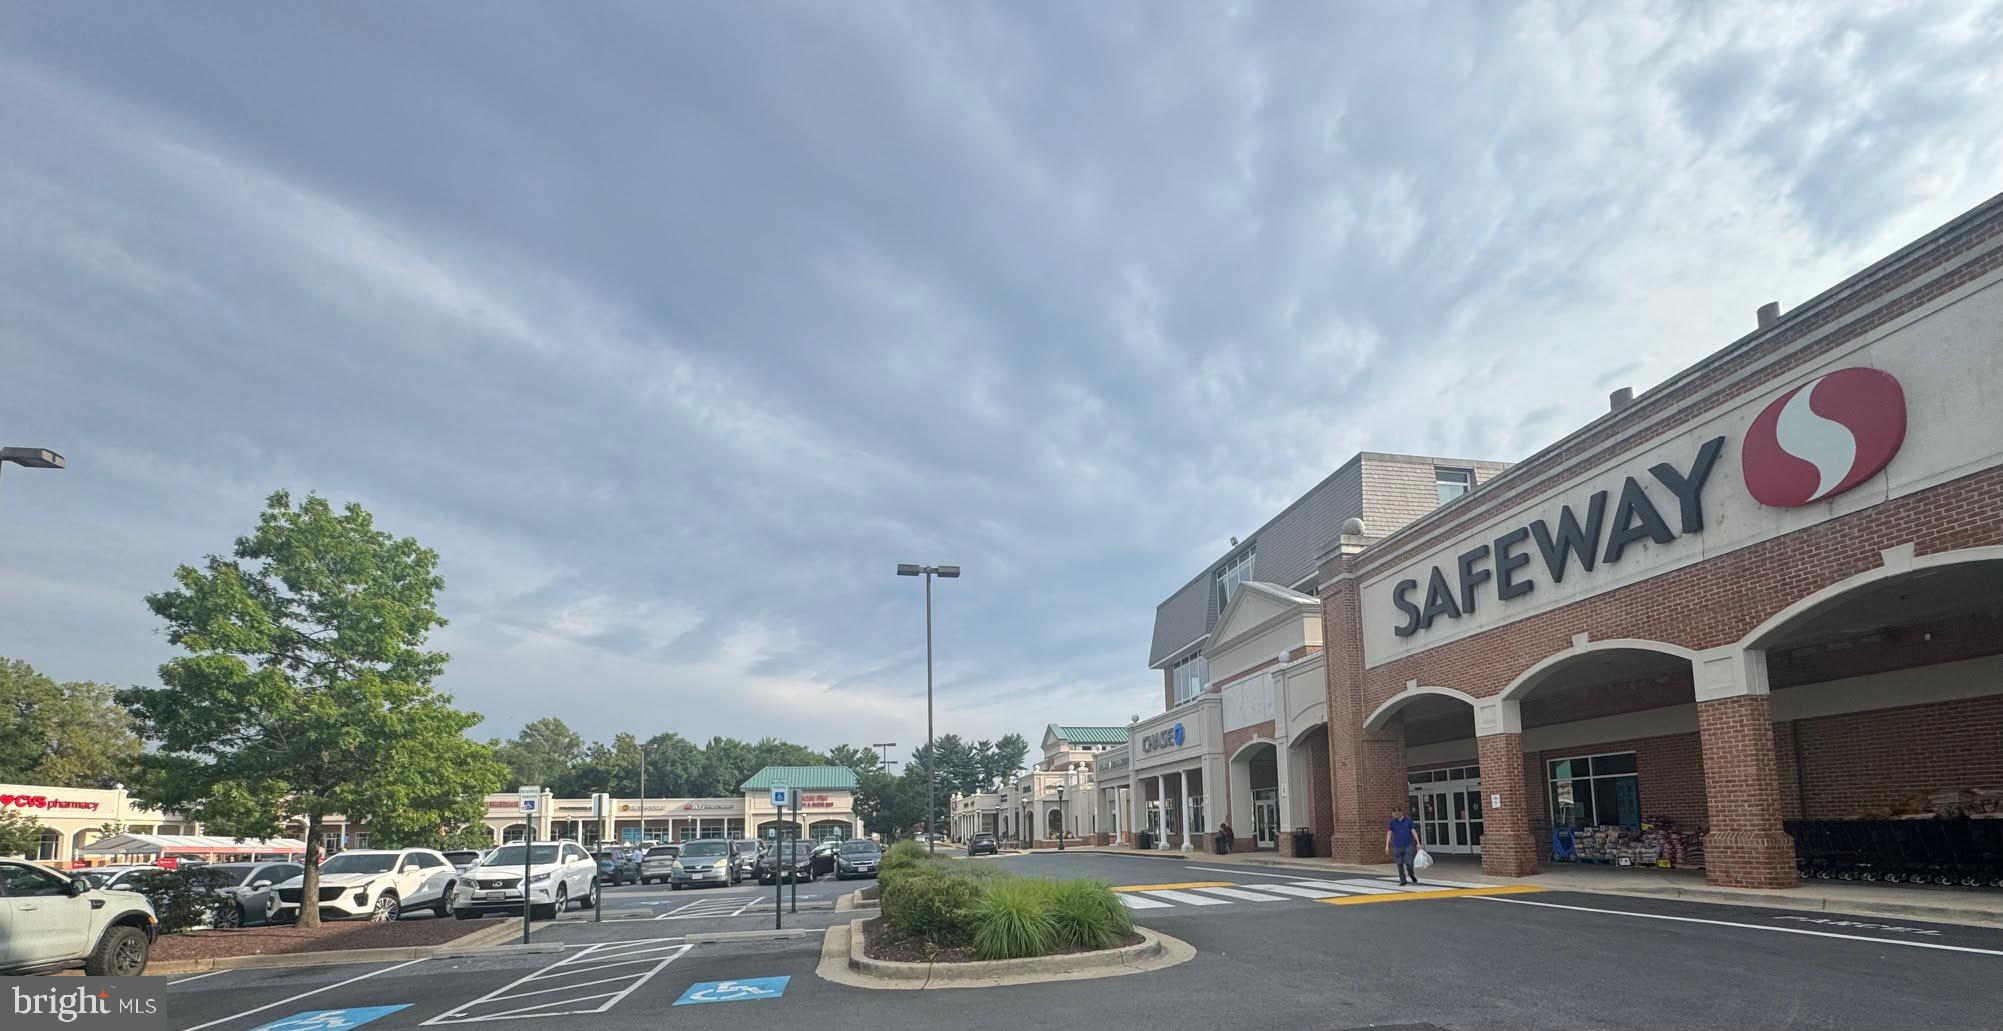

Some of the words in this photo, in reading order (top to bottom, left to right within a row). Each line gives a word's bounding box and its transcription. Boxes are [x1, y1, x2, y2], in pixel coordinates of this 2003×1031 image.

[1393, 436, 1725, 637] SAFEWAY
[1142, 728, 1175, 753] CHASE
[14, 795, 47, 808] CVS
[47, 799, 99, 811] pharmacy
